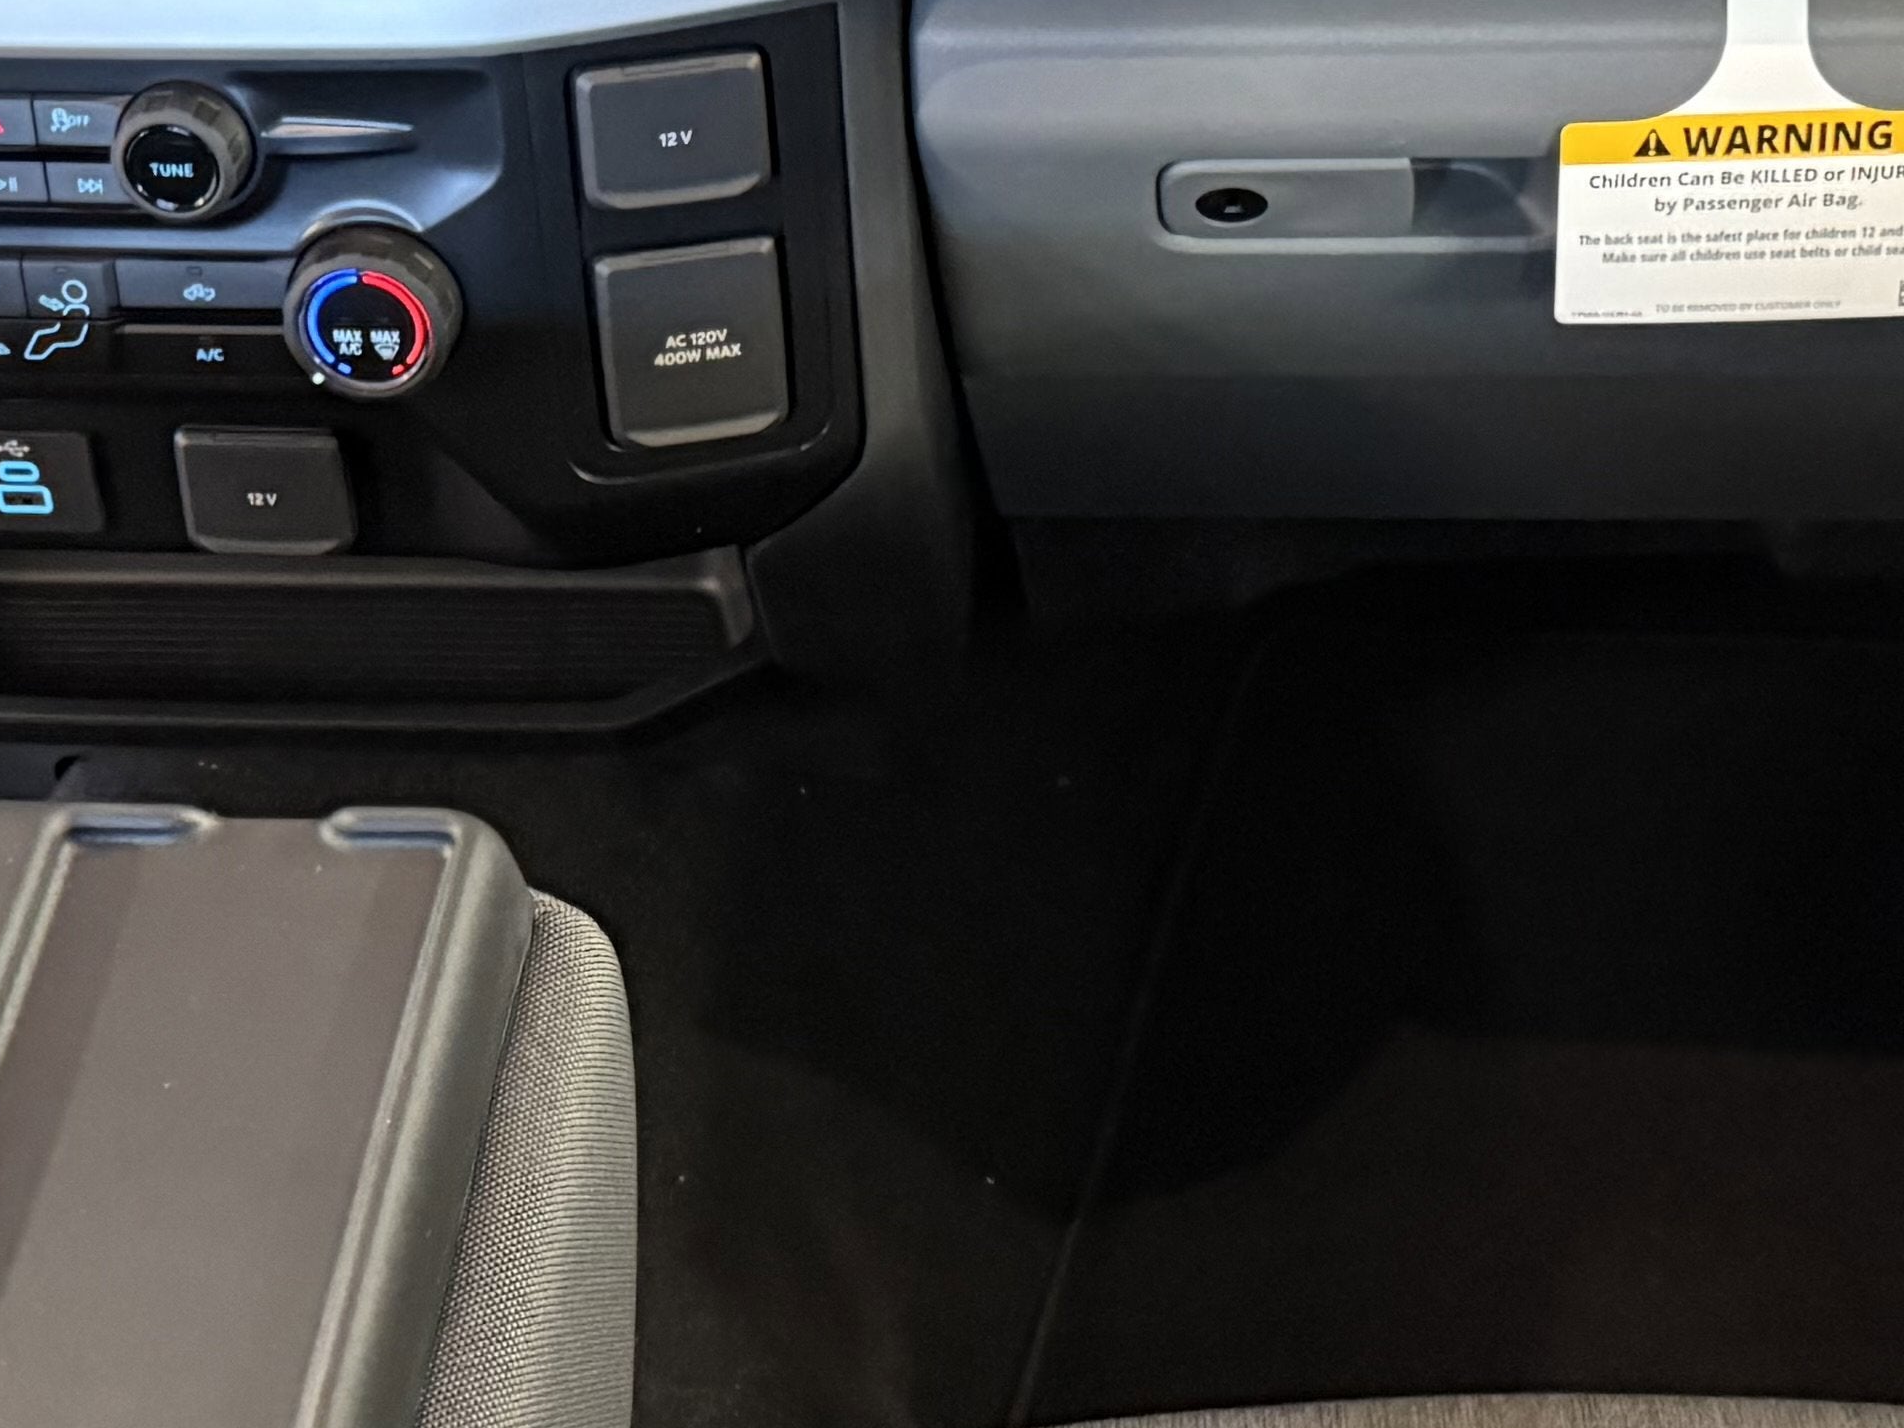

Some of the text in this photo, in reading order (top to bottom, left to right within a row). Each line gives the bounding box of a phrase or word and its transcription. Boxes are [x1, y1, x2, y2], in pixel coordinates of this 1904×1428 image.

[67, 113, 90, 128] OFF
[658, 129, 693, 148] 12 V
[1683, 120, 1893, 157] WARNING
[149, 162, 194, 178] TUNE
[1589, 172, 1672, 189] Children
[1678, 171, 1714, 187] Can
[1721, 170, 1745, 186] Be
[1751, 167, 1818, 185] KILLED
[1824, 169, 1845, 183] or
[1654, 192, 1863, 216] by Passenger Air Bag.
[1578, 234, 1601, 247] The
[1605, 233, 1634, 246] back
[1637, 234, 1664, 246] seat
[1667, 233, 1677, 245] is
[1681, 232, 1702, 244] the
[1705, 230, 1743, 243] safest
[1746, 229, 1779, 245] place
[1783, 228, 1802, 241] for
[1805, 226, 1857, 240] children
[1862, 225, 1876, 239] 12
[1879, 225, 1904, 238] and
[1602, 252, 1637, 264] Make
[1640, 253, 1667, 263] sure
[1670, 250, 1687, 263] all
[1689, 249, 1741, 262] children
[1744, 250, 1767, 261] use
[1770, 248, 1796, 259] seat
[1799, 246, 1831, 259] belts
[1834, 247, 1848, 257] or
[1851, 244, 1882, 257] child
[332, 328, 401, 345] MAX MAX
[665, 328, 728, 349] AC 120V
[196, 347, 224, 361] A/C
[338, 341, 363, 357] A/C
[653, 343, 742, 366] 400W MAX
[247, 492, 278, 507] 12 V
